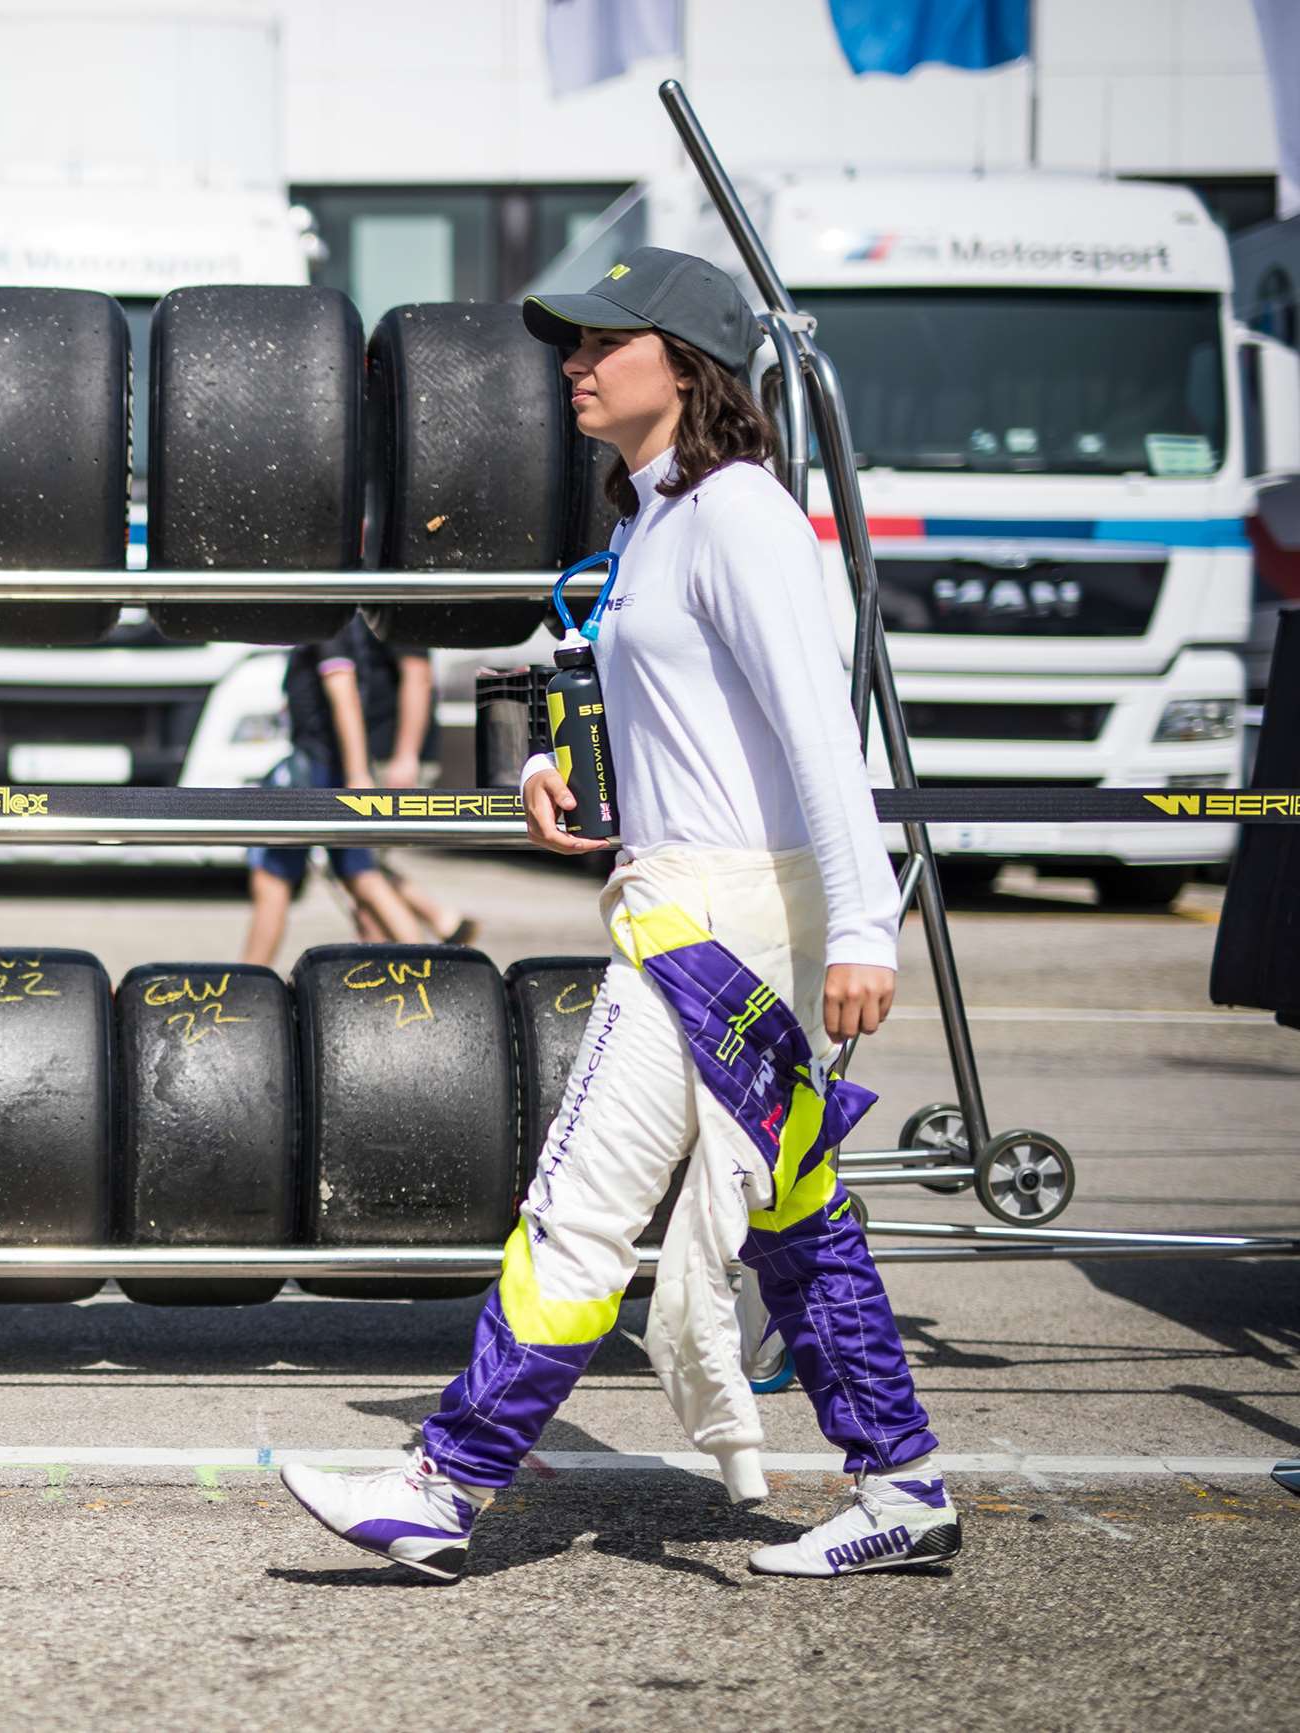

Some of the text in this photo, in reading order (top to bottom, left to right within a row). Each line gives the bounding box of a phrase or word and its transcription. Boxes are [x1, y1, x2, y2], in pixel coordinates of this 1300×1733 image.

[950, 240, 1172, 273] Motorsport
[579, 704, 604, 716] 55
[591, 724, 608, 801] CHADWICK
[1206, 795, 1300, 815] SERI
[343, 959, 431, 989] CW
[167, 1003, 252, 1046] 22
[384, 983, 434, 1028] 21
[824, 1525, 915, 1576] PUMA
